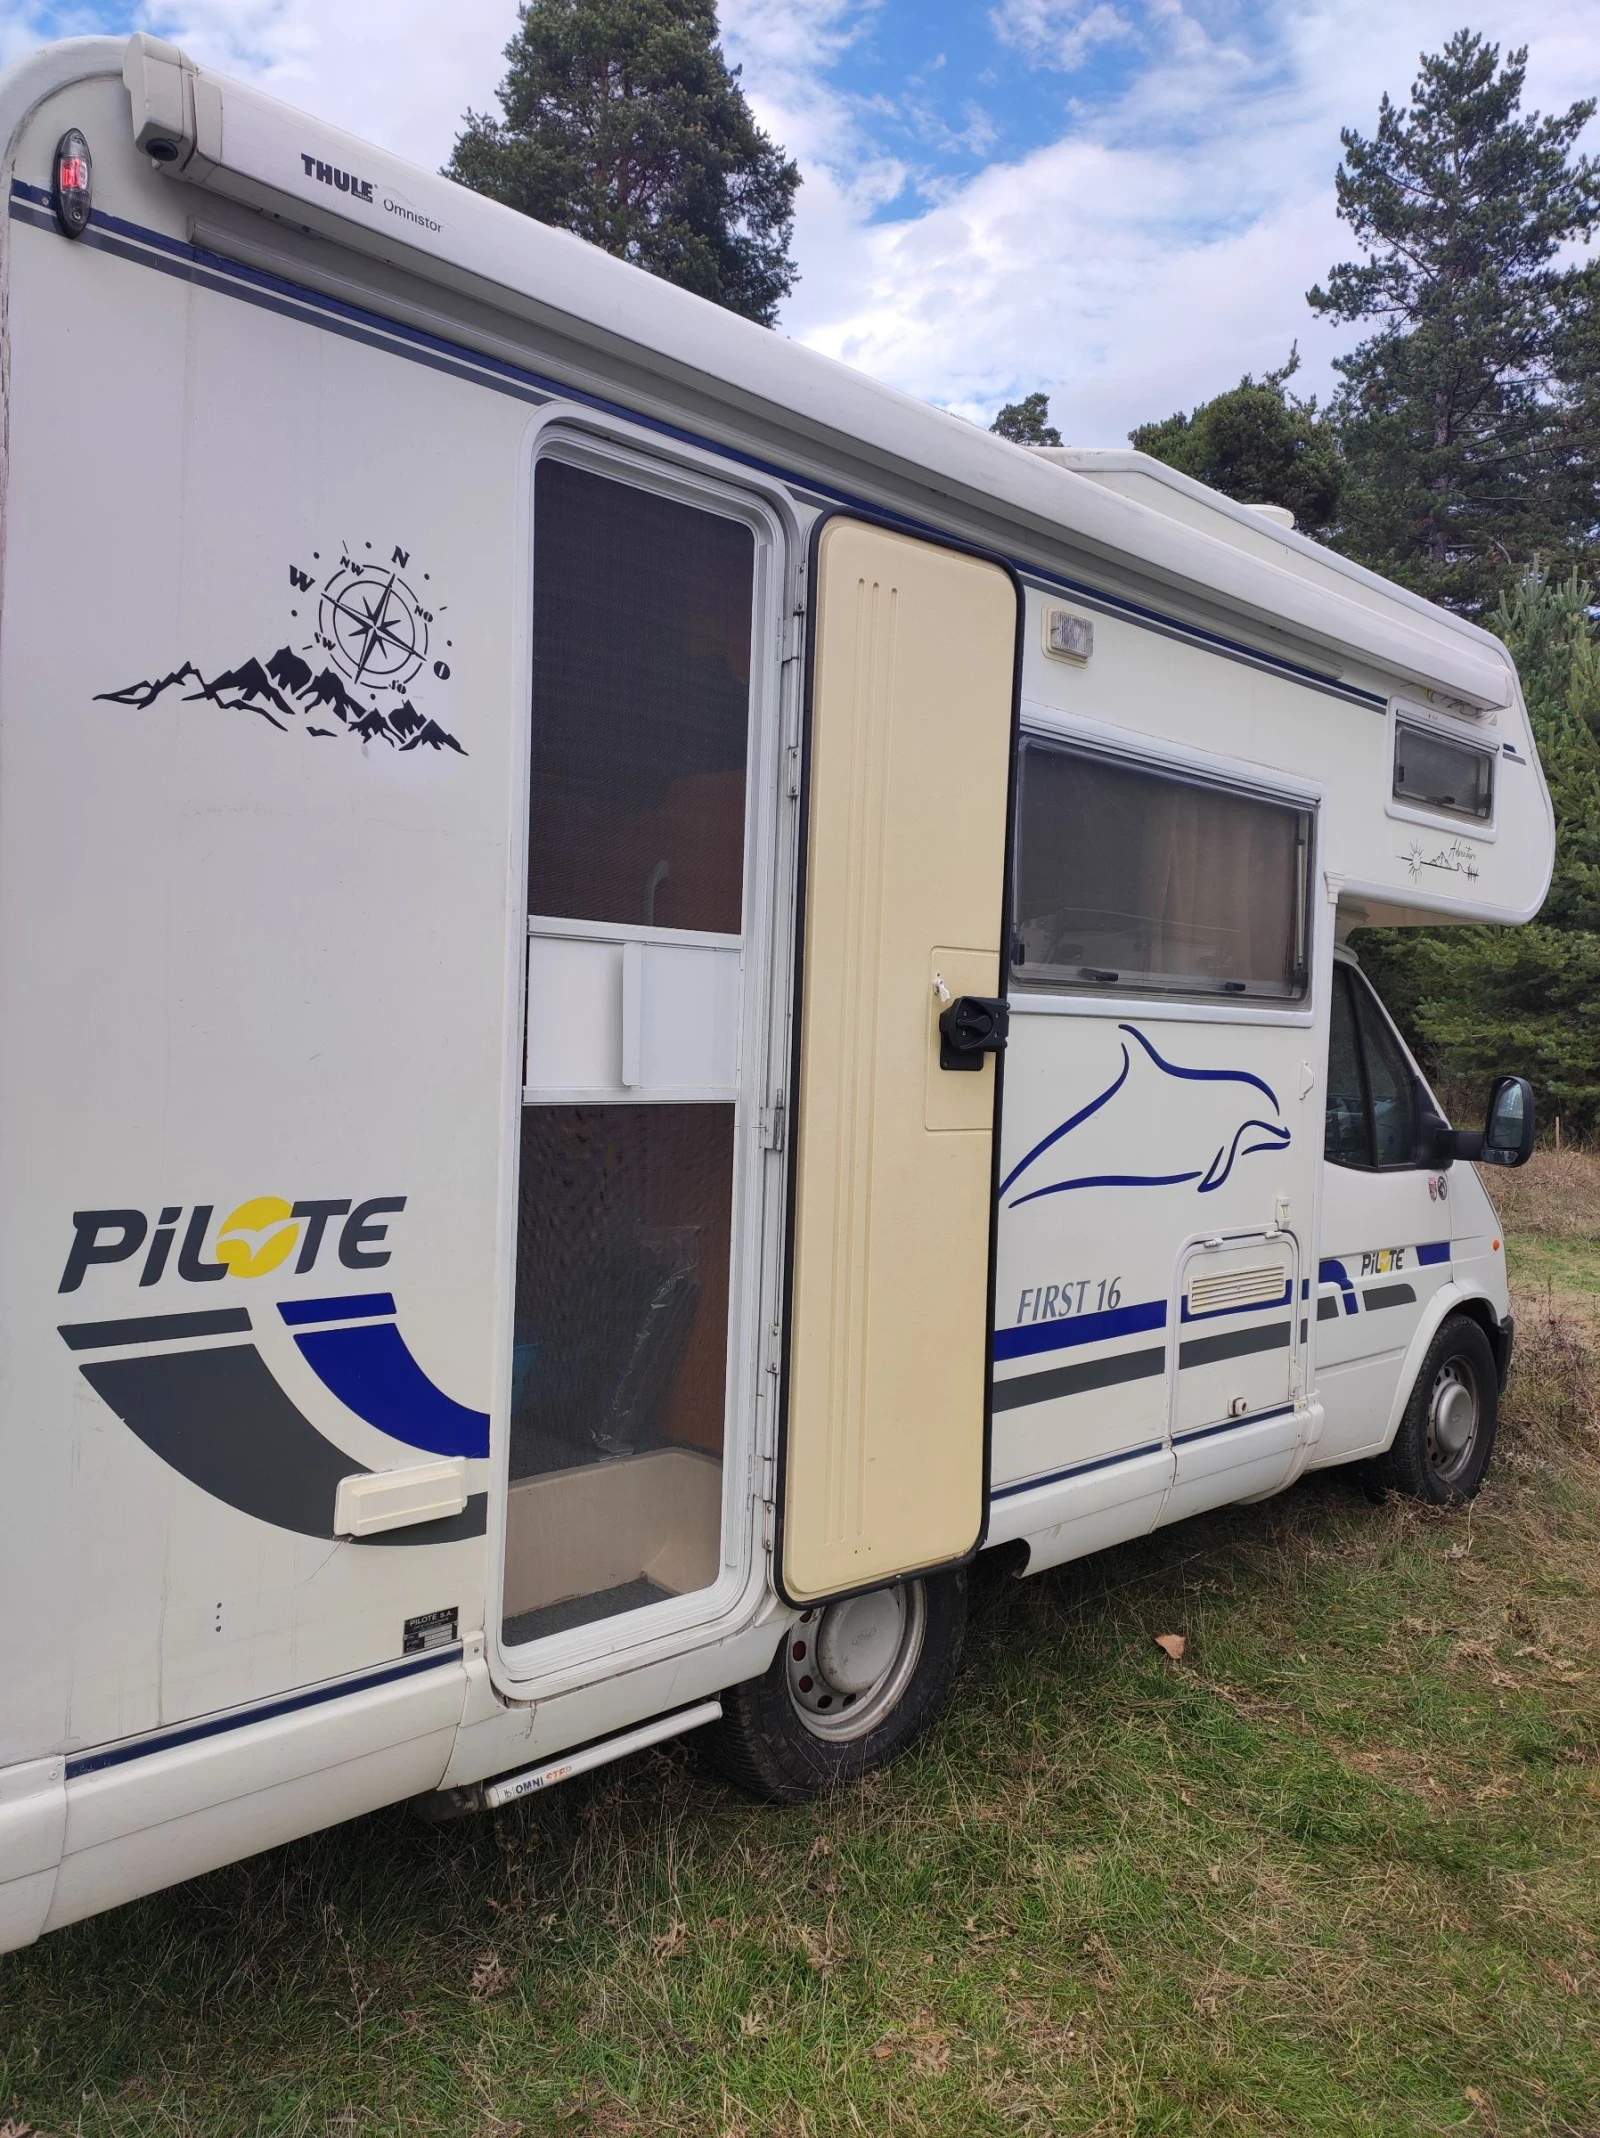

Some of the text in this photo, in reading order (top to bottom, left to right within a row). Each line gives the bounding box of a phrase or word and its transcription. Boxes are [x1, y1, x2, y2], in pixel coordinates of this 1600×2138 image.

[300, 152, 443, 233] THULE Omnistor
[339, 555, 365, 577] NW
[391, 545, 410, 569] N
[289, 564, 316, 593] W
[414, 604, 434, 623] NO
[1016, 1276, 1122, 1324] FIRST 16
[409, 1613, 438, 1627] PILOTE
[515, 1776, 545, 1794] OMNI
